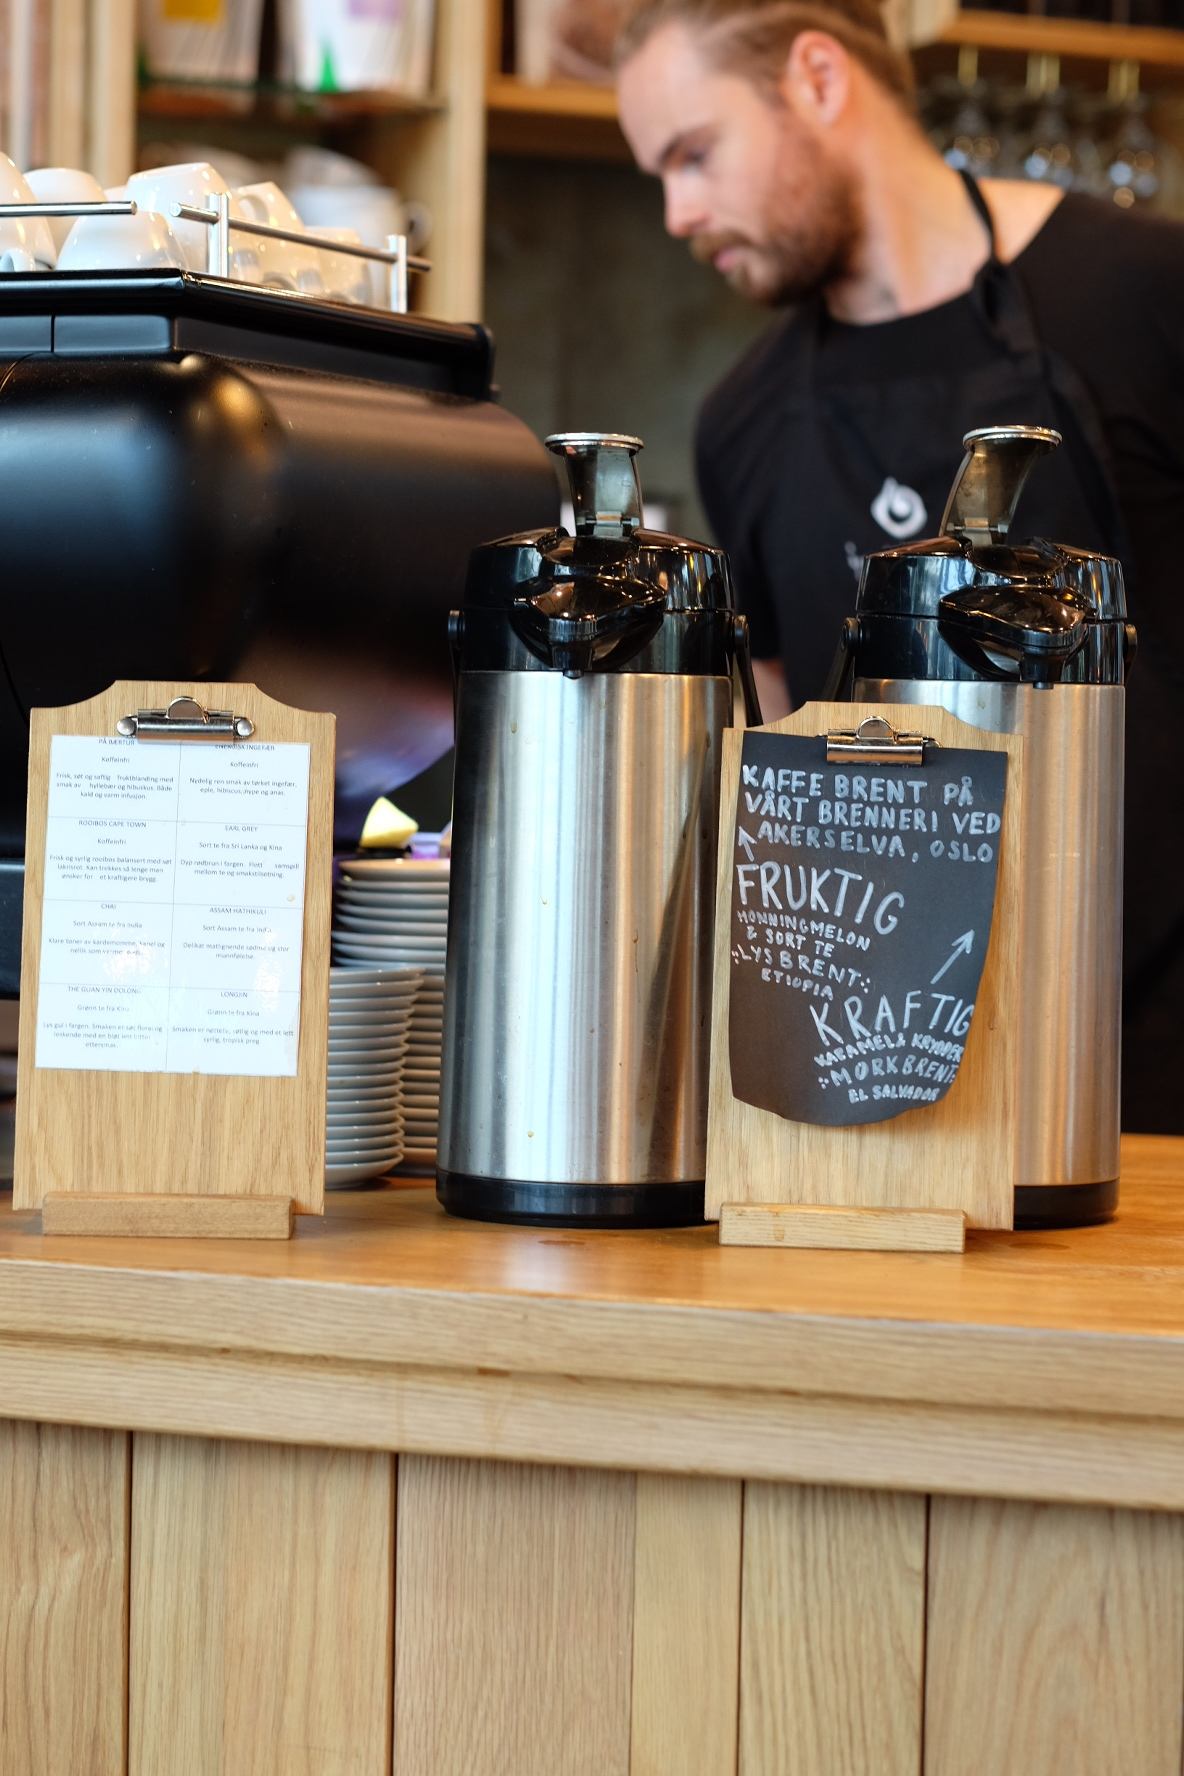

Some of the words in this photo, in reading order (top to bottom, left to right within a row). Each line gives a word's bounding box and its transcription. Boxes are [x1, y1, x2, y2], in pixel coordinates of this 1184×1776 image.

[742, 764, 823, 797] KAFFE
[835, 774, 927, 804] BRENT
[943, 776, 973, 807] PÅ
[745, 790, 809, 822] VÅRT
[818, 800, 938, 832] BRENNERI
[952, 812, 1001, 835] VED
[757, 820, 920, 863] AKERSELVA,
[930, 840, 994, 863] OSLO
[736, 861, 905, 935] FRUKTIG
[737, 909, 870, 951] HONNINGMELON
[766, 928, 806, 950] SORT
[814, 940, 835, 958] TE
[737, 944, 773, 965] LYS
[761, 968, 834, 1001] ETIOPIA
[809, 990, 975, 1047] KRAFTIG
[848, 1088, 868, 1103] EL
[872, 1084, 940, 1101] SALVADOR
